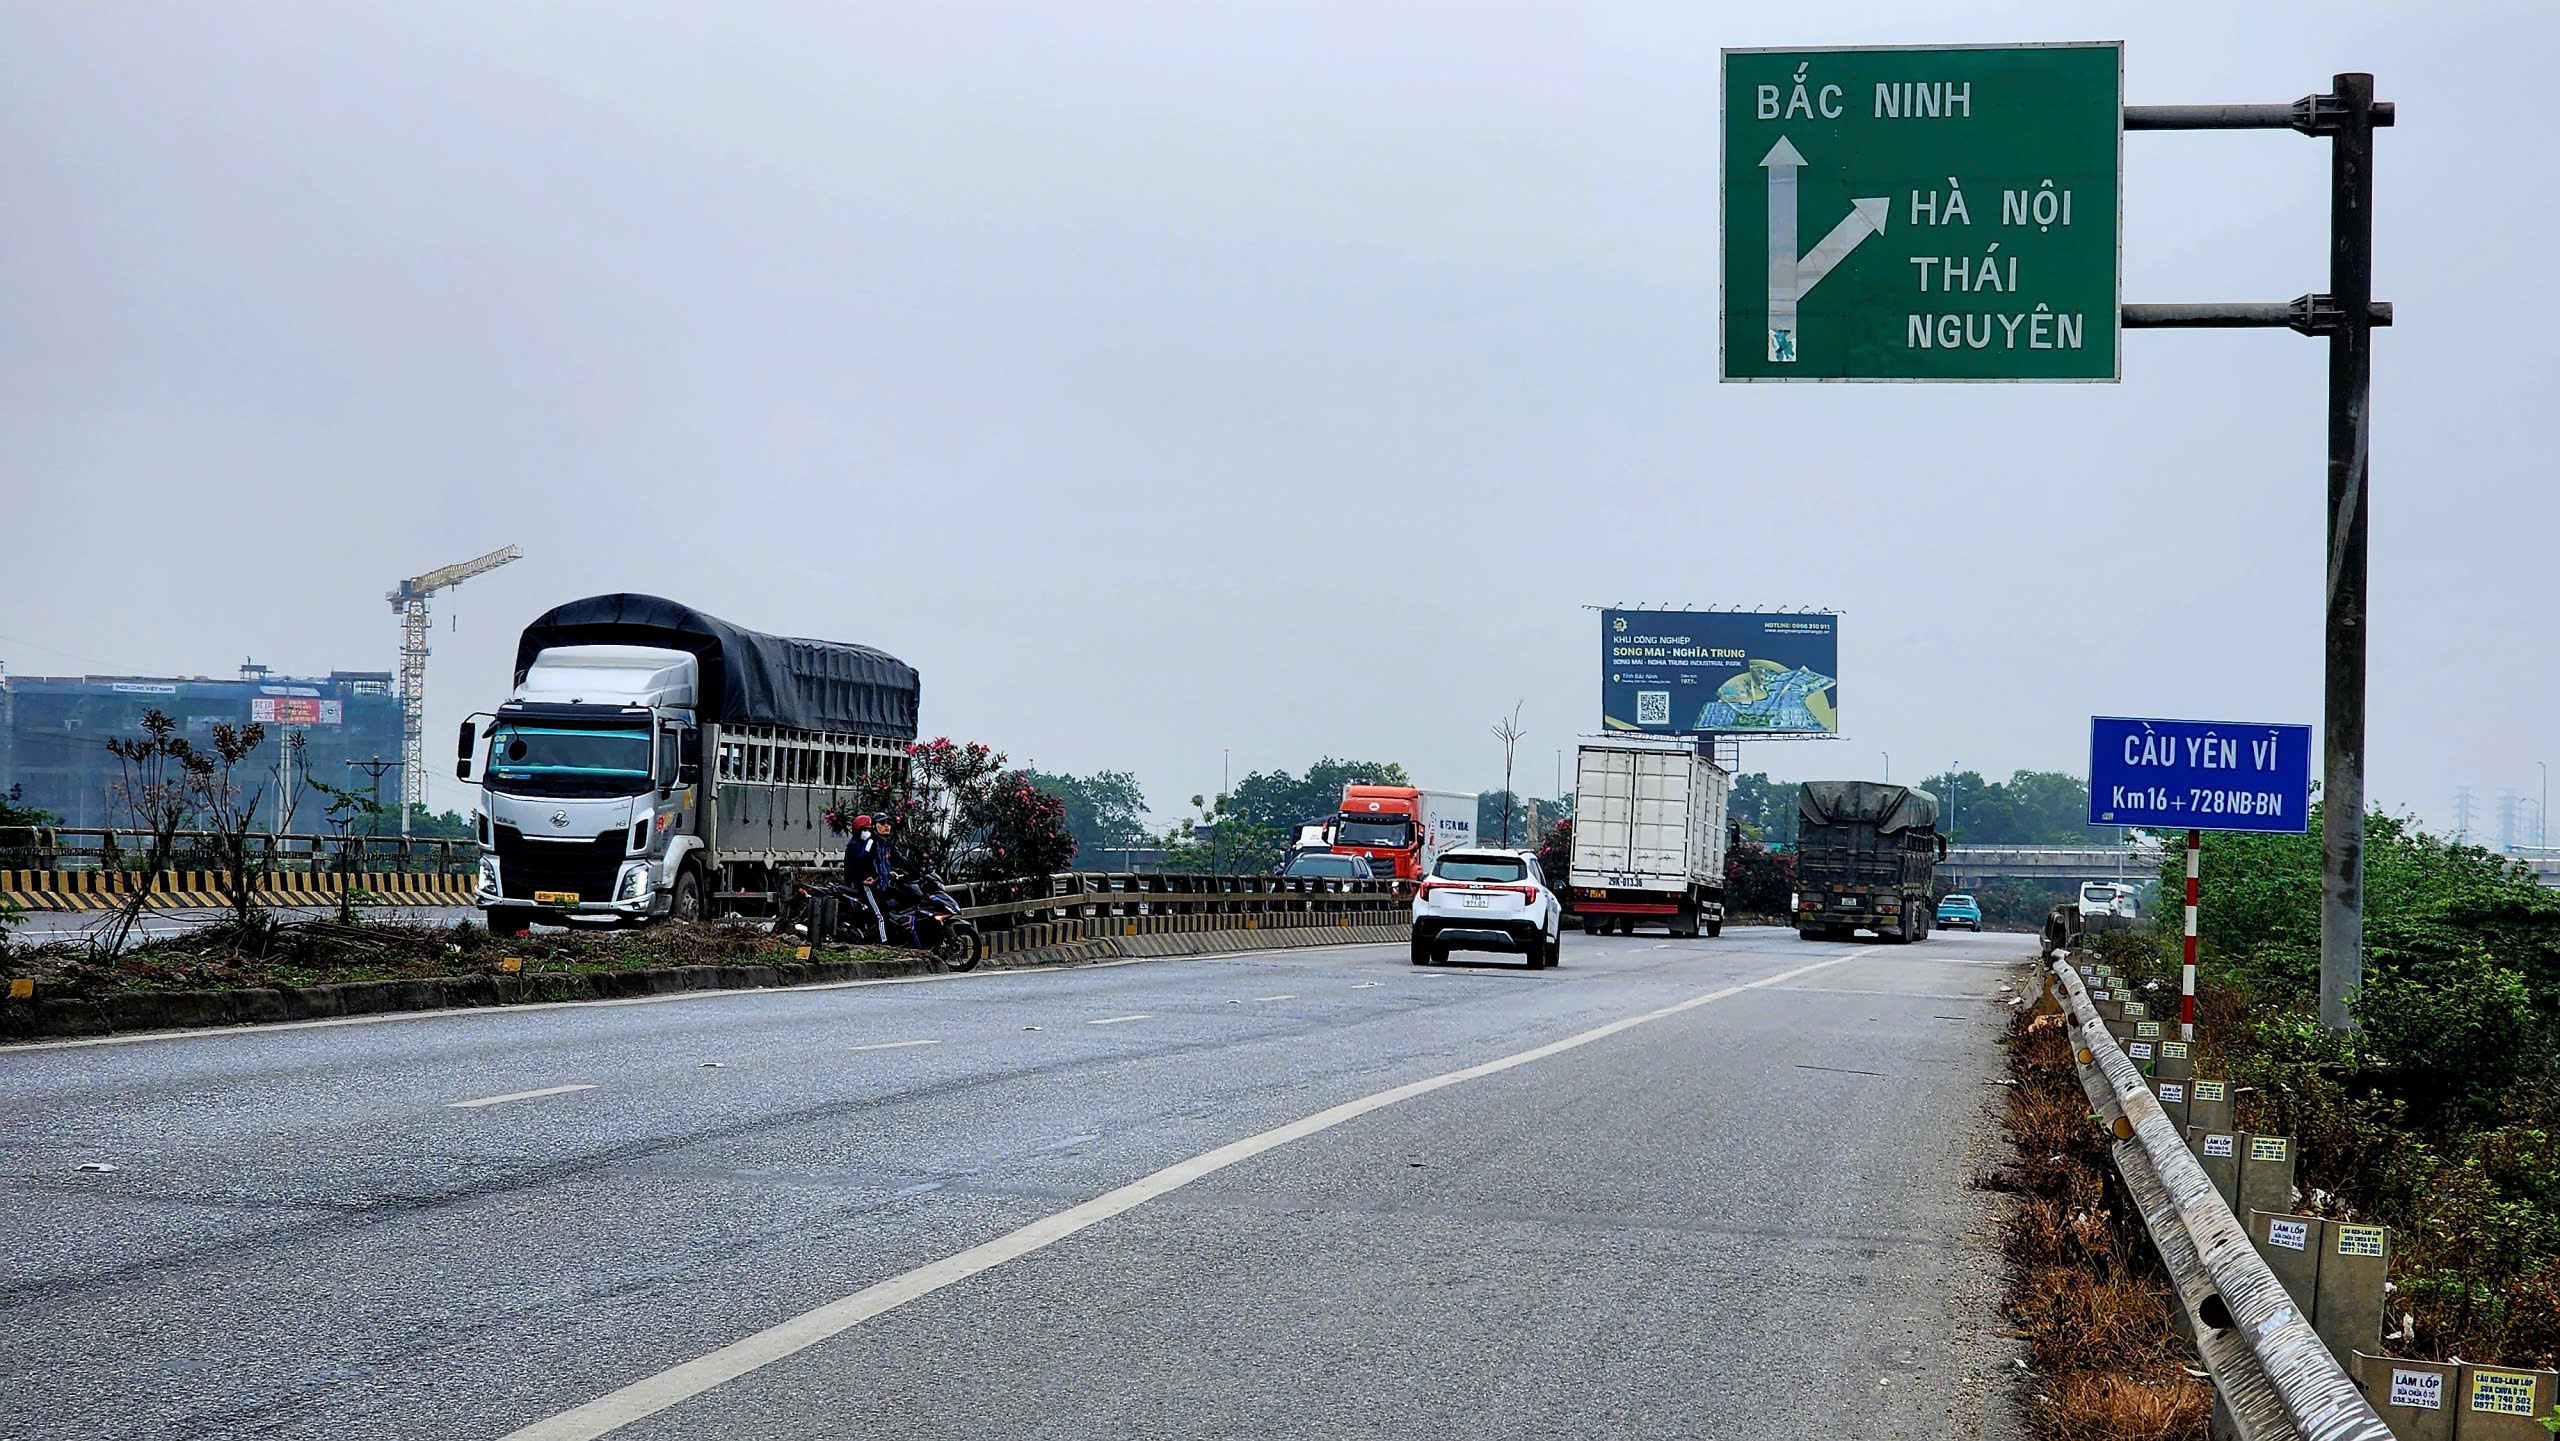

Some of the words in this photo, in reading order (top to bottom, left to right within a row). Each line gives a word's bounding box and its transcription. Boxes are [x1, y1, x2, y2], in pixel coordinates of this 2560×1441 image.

[1757, 61, 1844, 121] BẮC
[1874, 82, 1971, 119] NINH
[1911, 177, 1970, 226] HÀ
[2002, 178, 2071, 232] NỘI
[1911, 242, 2017, 293] THÁI
[1908, 302, 2083, 349] NGUYÊN
[1613, 636, 1632, 644] KHU
[1634, 636, 1658, 644] CÔNG
[1660, 636, 1690, 646] NGHIỆP
[1613, 648, 1642, 656] SONG
[1644, 648, 1664, 656] MAI
[1672, 646, 1708, 657] NGHĨA
[1710, 649, 1746, 658] TRUNG
[2124, 722, 2176, 767] CẦU
[2186, 731, 2237, 770] YÊN
[2252, 729, 2279, 771] VĨ
[2274, 1224, 2288, 1232] LÀM
[2290, 1225, 2304, 1234] LỐP
[2396, 1375, 2416, 1387] LÀM
[2420, 1376, 2439, 1388] LỐP
[2520, 1377, 2533, 1386] LỐP
[2392, 1396, 2438, 1408] 038.342.3150
[2498, 1403, 2513, 1411] 128
[2515, 1404, 2531, 1412] 002
